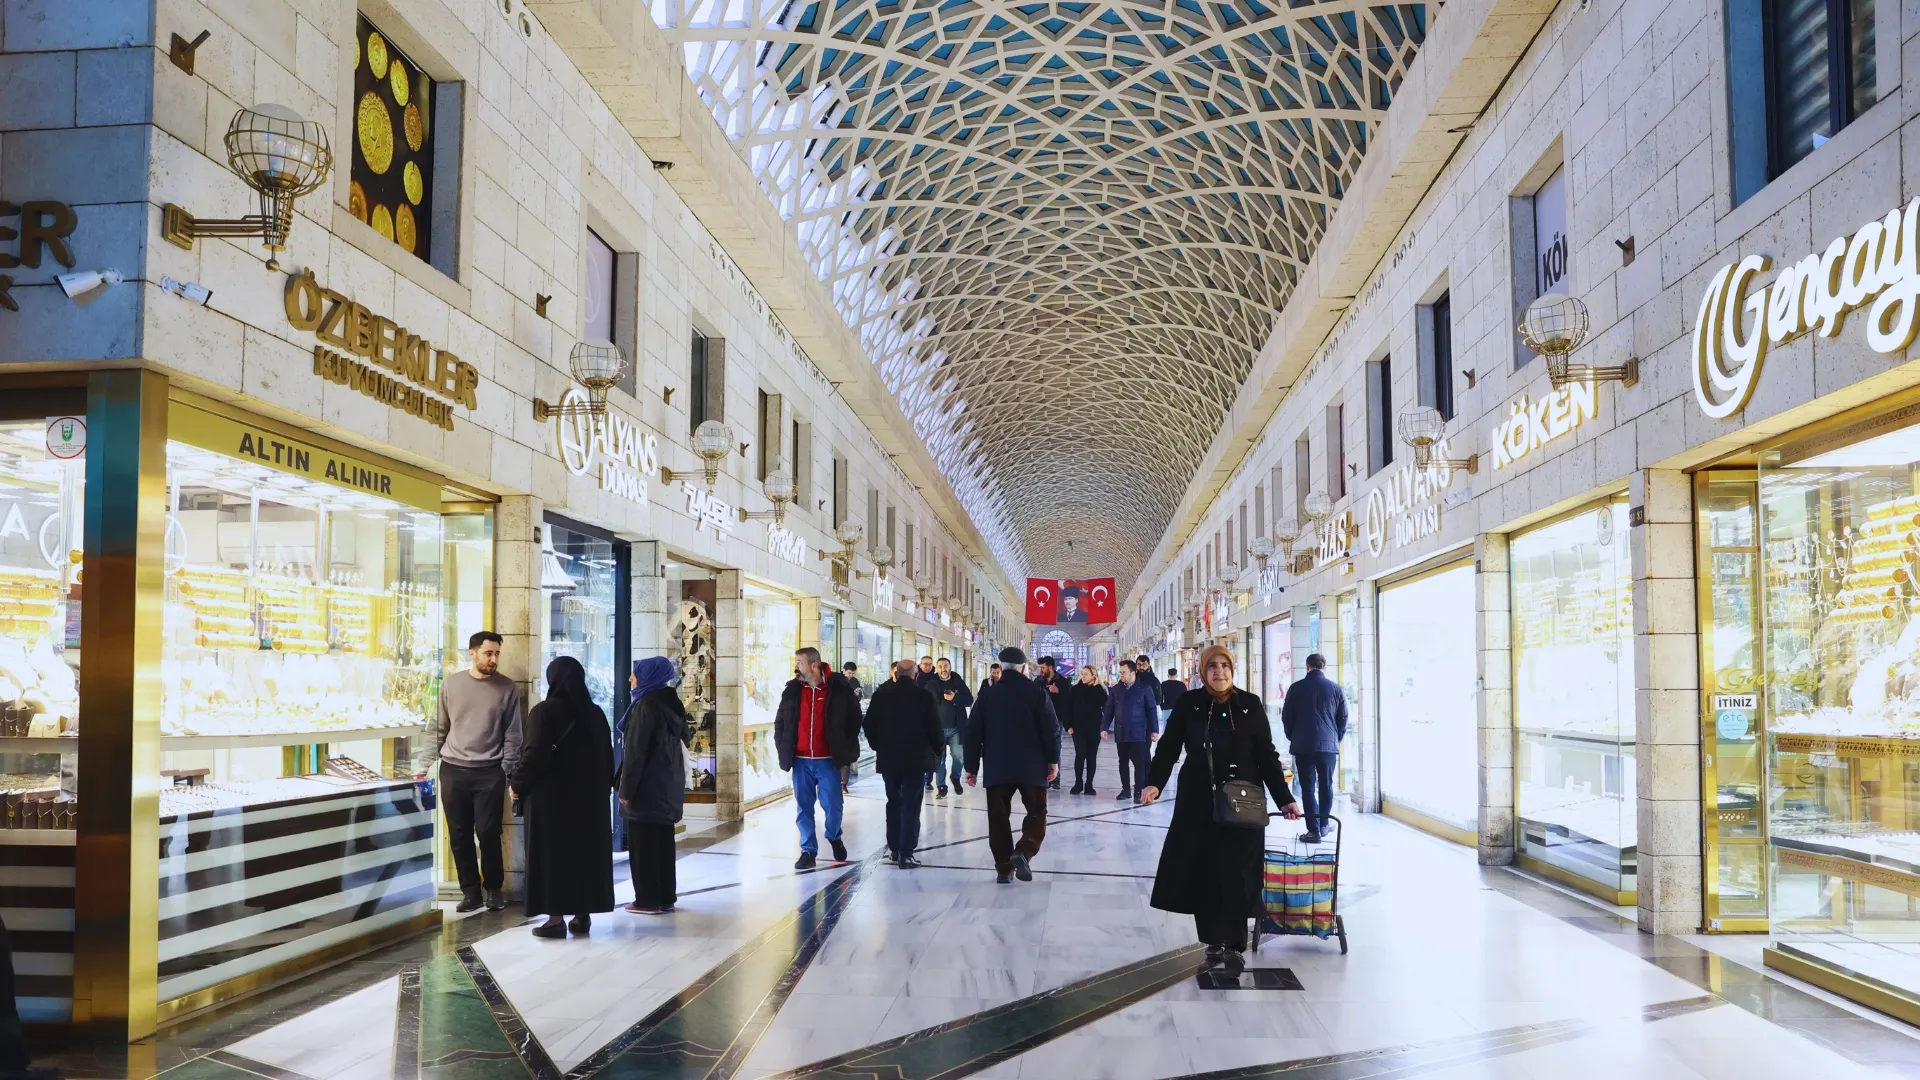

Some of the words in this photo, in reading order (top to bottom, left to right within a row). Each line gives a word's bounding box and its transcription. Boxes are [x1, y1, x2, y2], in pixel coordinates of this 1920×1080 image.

[284, 266, 478, 411] ÖZBEKLER
[313, 345, 455, 431] KUYUMCULUK
[1493, 368, 1596, 470] KÖKEN
[238, 432, 310, 473] ALTIN
[324, 459, 392, 496] ALINIR
[1395, 504, 1440, 549] DÜNYASI
[1717, 696, 1753, 708] İTİNİZ
